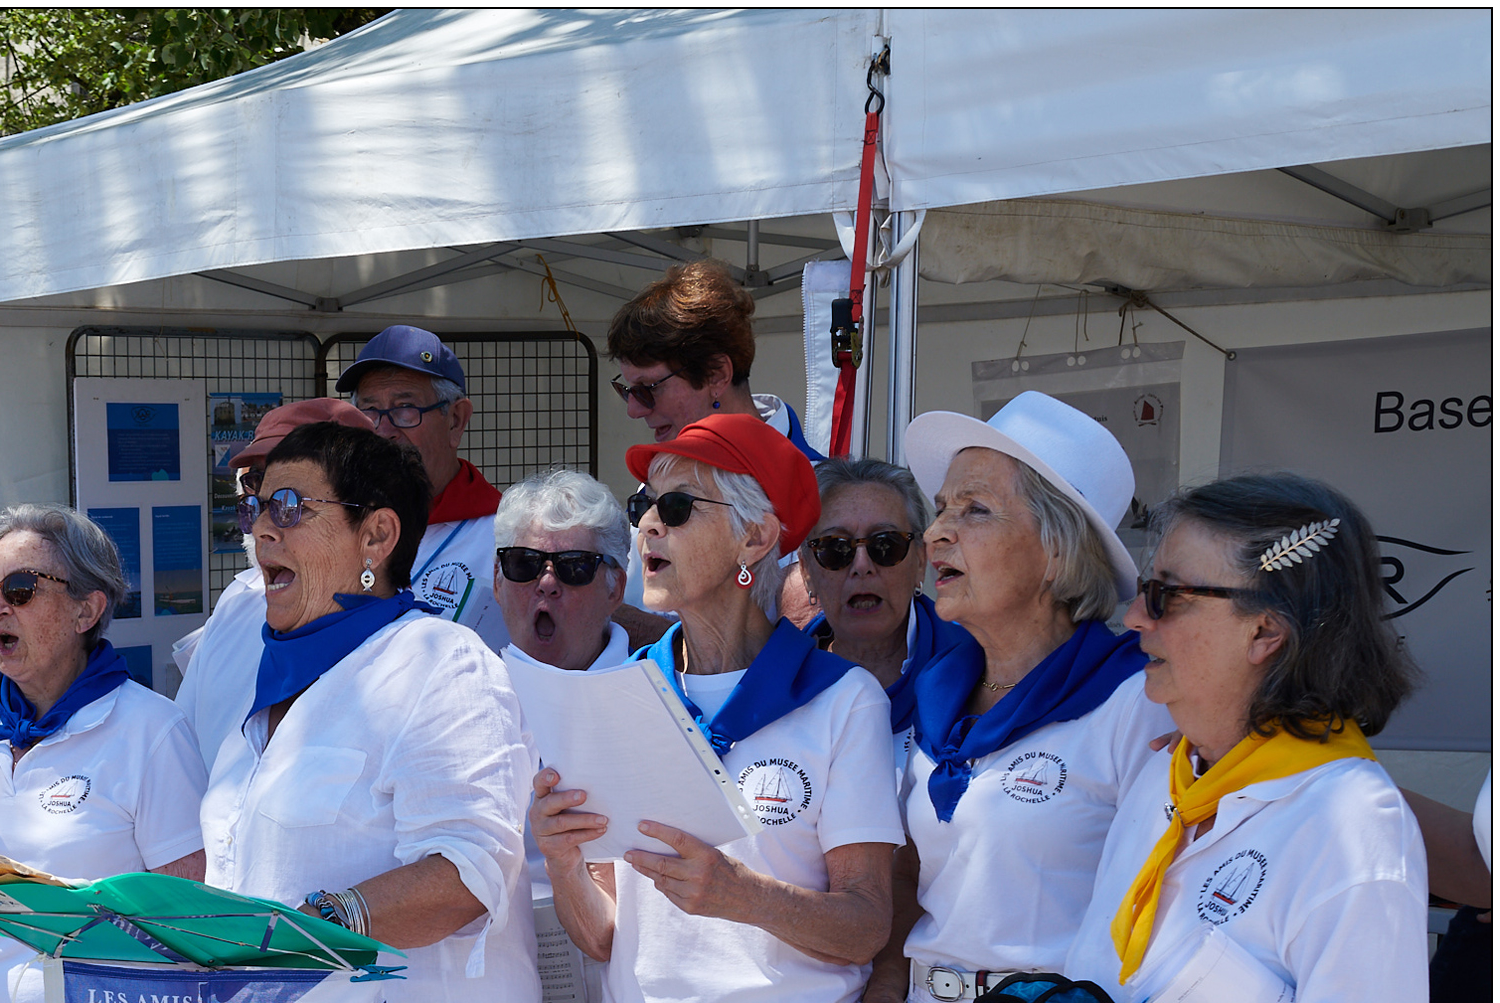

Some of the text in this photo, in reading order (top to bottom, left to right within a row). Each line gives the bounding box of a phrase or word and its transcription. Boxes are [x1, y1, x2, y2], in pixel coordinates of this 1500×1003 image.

[214, 430, 245, 441] KAYAK
[429, 592, 455, 604] JOSHUA
[1008, 755, 1024, 772] AMIS
[1024, 752, 1036, 760] DU
[738, 758, 812, 810] AMIS DU MUSEE MARITIME
[1011, 784, 1043, 796] JOSHUA
[1003, 787, 1051, 804] LA ROCHELLE
[752, 804, 789, 815] JOSHUA
[758, 812, 797, 826] OCHELLE
